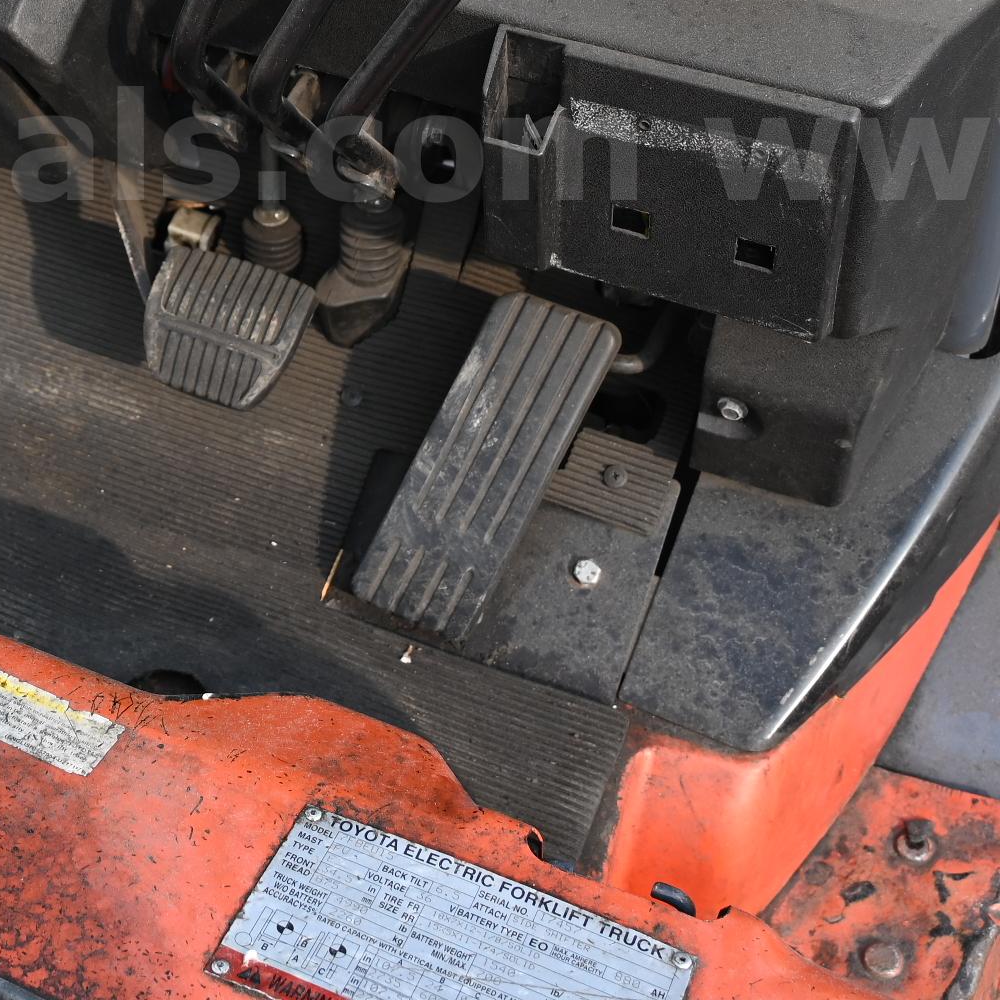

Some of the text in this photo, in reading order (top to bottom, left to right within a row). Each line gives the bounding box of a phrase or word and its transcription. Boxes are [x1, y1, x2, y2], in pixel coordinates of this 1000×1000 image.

[296, 830, 323, 846] MAST
[302, 821, 336, 839] MODEL
[290, 840, 316, 856] TYPE
[278, 859, 312, 877] TREAD
[283, 851, 316, 869] FRONT
[366, 885, 378, 894] in
[380, 864, 408, 881] BACK
[407, 875, 429, 889] TILT
[271, 881, 324, 908] W/O BATTERY
[328, 814, 668, 959] TOYOTA ELECTRIC FORKLIFT TRUCK
[364, 871, 407, 894] VOLTAGE
[447, 904, 457, 913] V
[271, 871, 300, 888] TRUCK
[297, 882, 328, 900] WEIGHT
[396, 923, 409, 934] lb
[376, 900, 400, 915] SIZE
[399, 911, 416, 923] RR
[380, 892, 405, 907] TIRE
[405, 900, 421, 912] FR
[471, 901, 509, 922] ATTACH
[476, 889, 514, 910] SERIAL
[511, 903, 531, 917] NO.
[390, 934, 406, 946] kg
[455, 907, 550, 952] BATTERY TYPE EO
[315, 914, 509, 1000] RATED CAPACITY WITH VERTICAL MAST EQUIPPED AT
[361, 954, 373, 963] in
[408, 930, 444, 950] BATTERY
[440, 944, 473, 963] WEIGHT
[549, 950, 603, 976] HOUR CAPACITY
[348, 976, 361, 986] in
[649, 988, 666, 1000] AH
